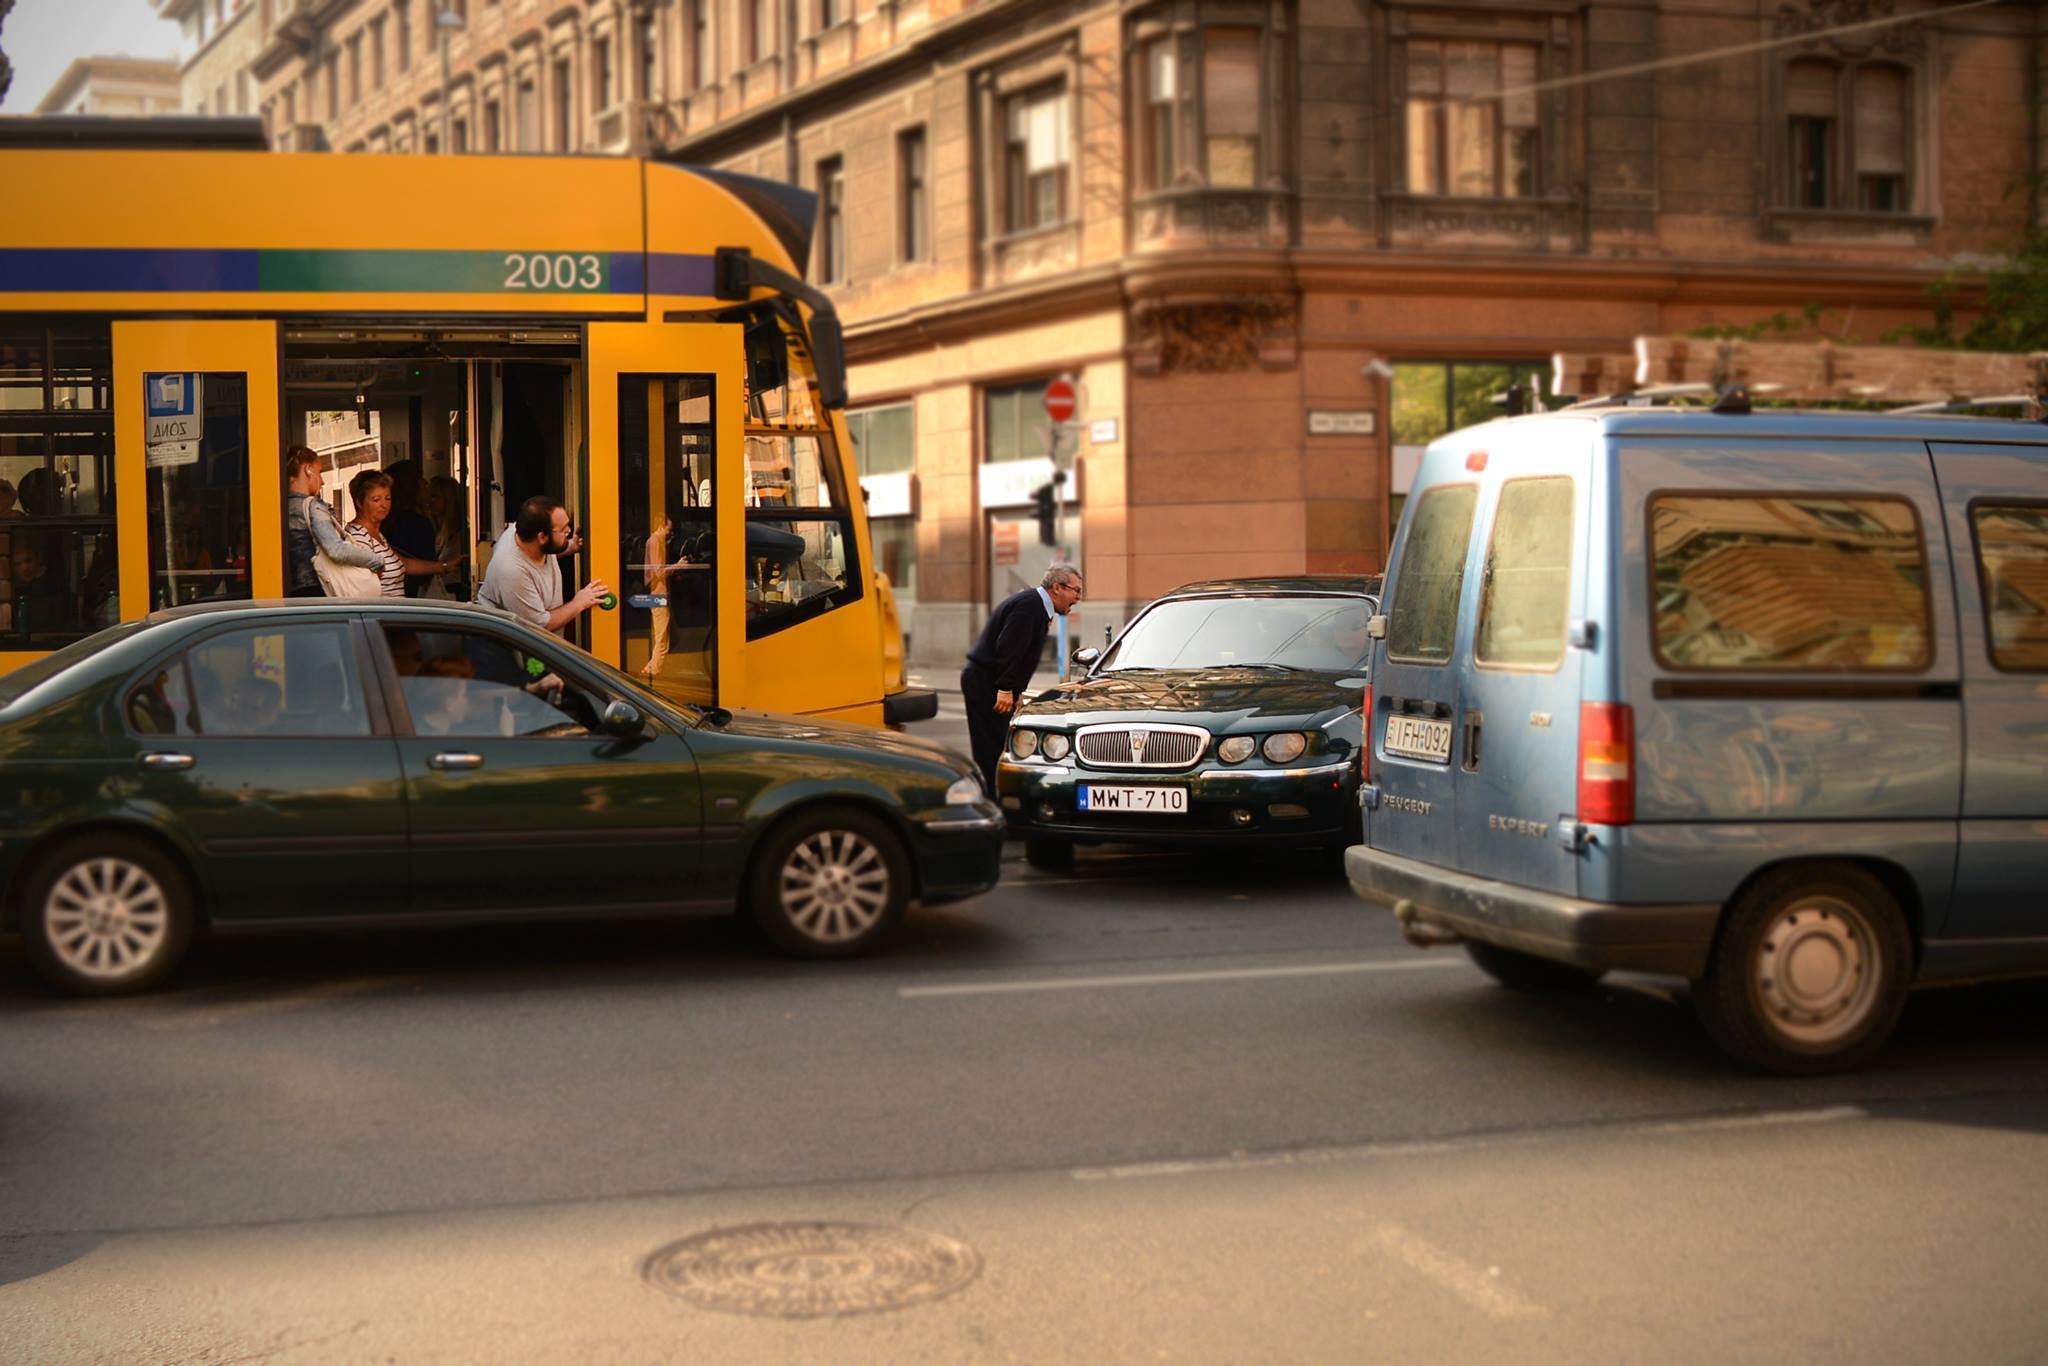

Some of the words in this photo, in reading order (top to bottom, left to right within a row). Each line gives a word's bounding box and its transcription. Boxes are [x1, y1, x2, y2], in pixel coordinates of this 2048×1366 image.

[504, 254, 602, 289] 2003
[1092, 789, 1182, 809] MWT-710
[1383, 794, 1432, 816] PEUGEOT
[1488, 814, 1549, 837] EXPERT
